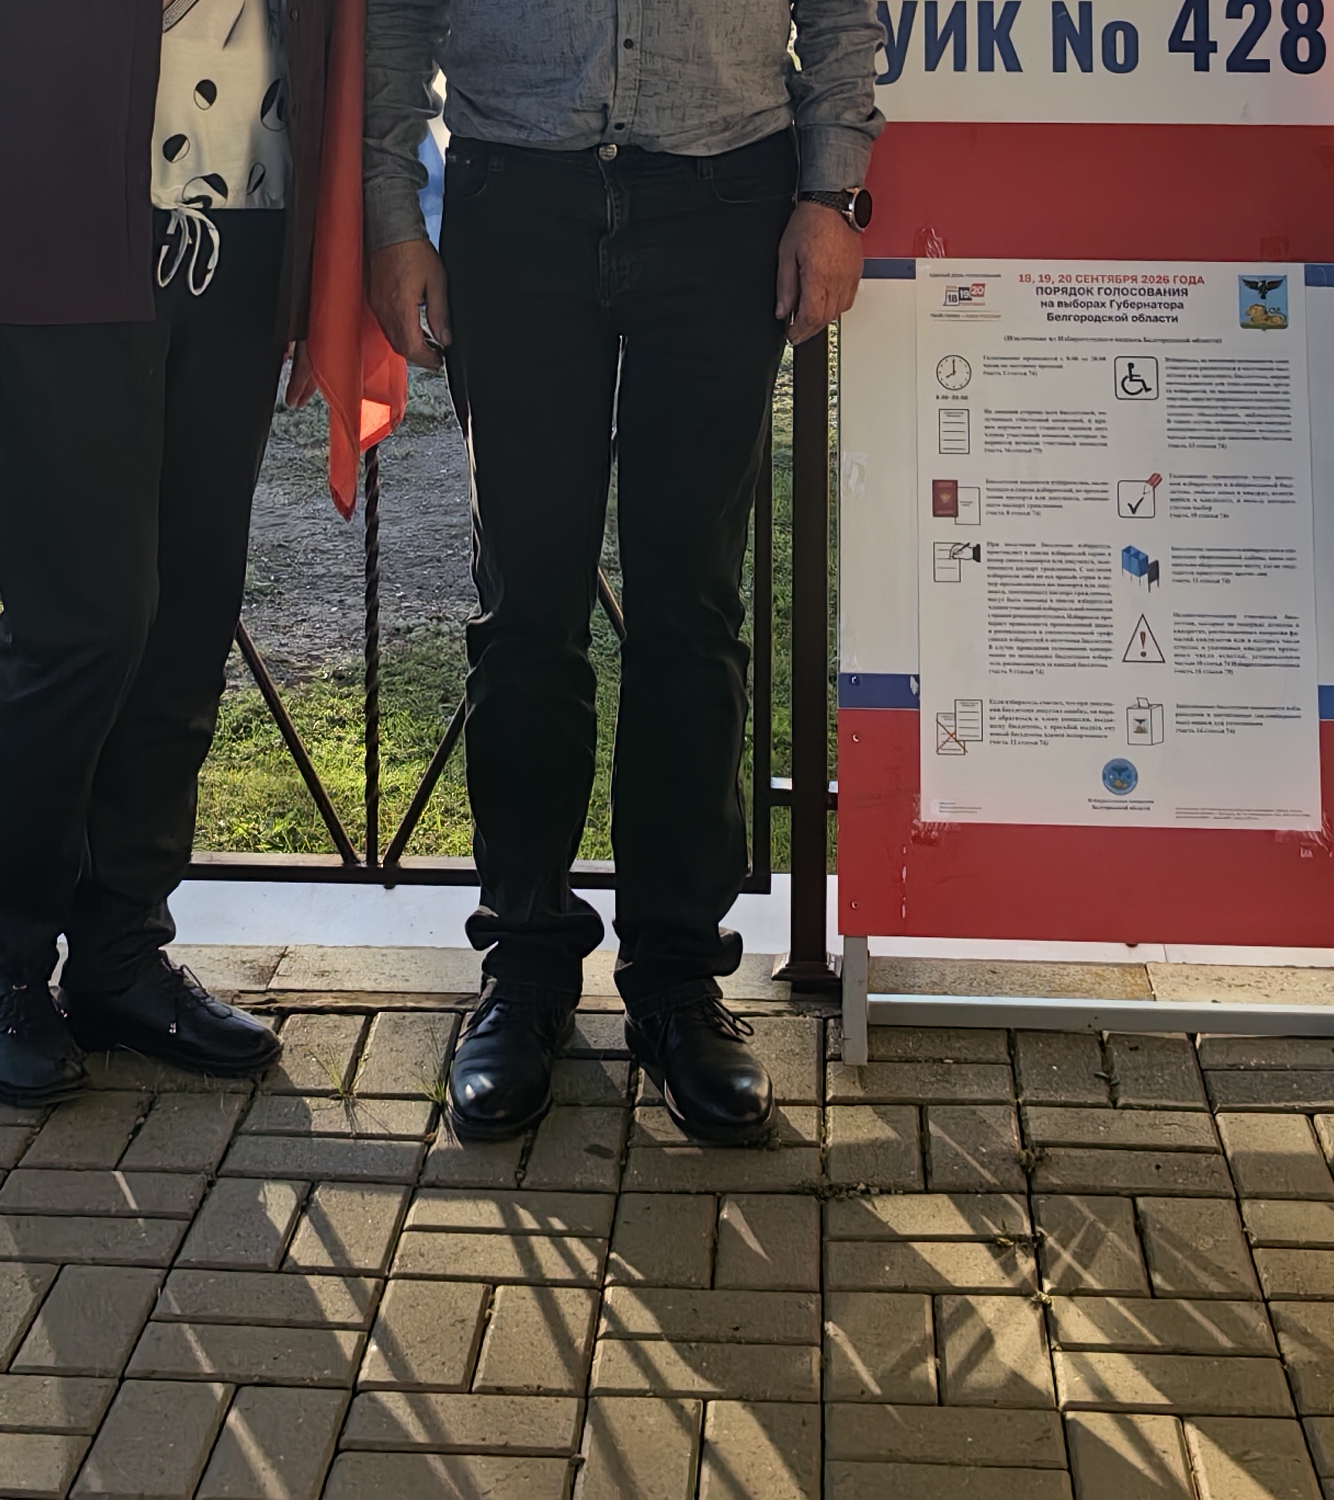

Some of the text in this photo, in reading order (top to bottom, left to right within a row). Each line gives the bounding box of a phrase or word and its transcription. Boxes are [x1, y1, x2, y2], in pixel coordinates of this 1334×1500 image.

[874, 0, 1024, 85] УИК
[1018, 274, 1205, 286] 18, 19, 20 СЕНТЯБРЯ 2026 ГОДА
[1035, 286, 1190, 298] ПОРЯДОК ГОЛОСОВАНИЯ
[1040, 299, 1185, 312] на выборах Губернатора
[1046, 312, 1180, 325] Белгородской области
